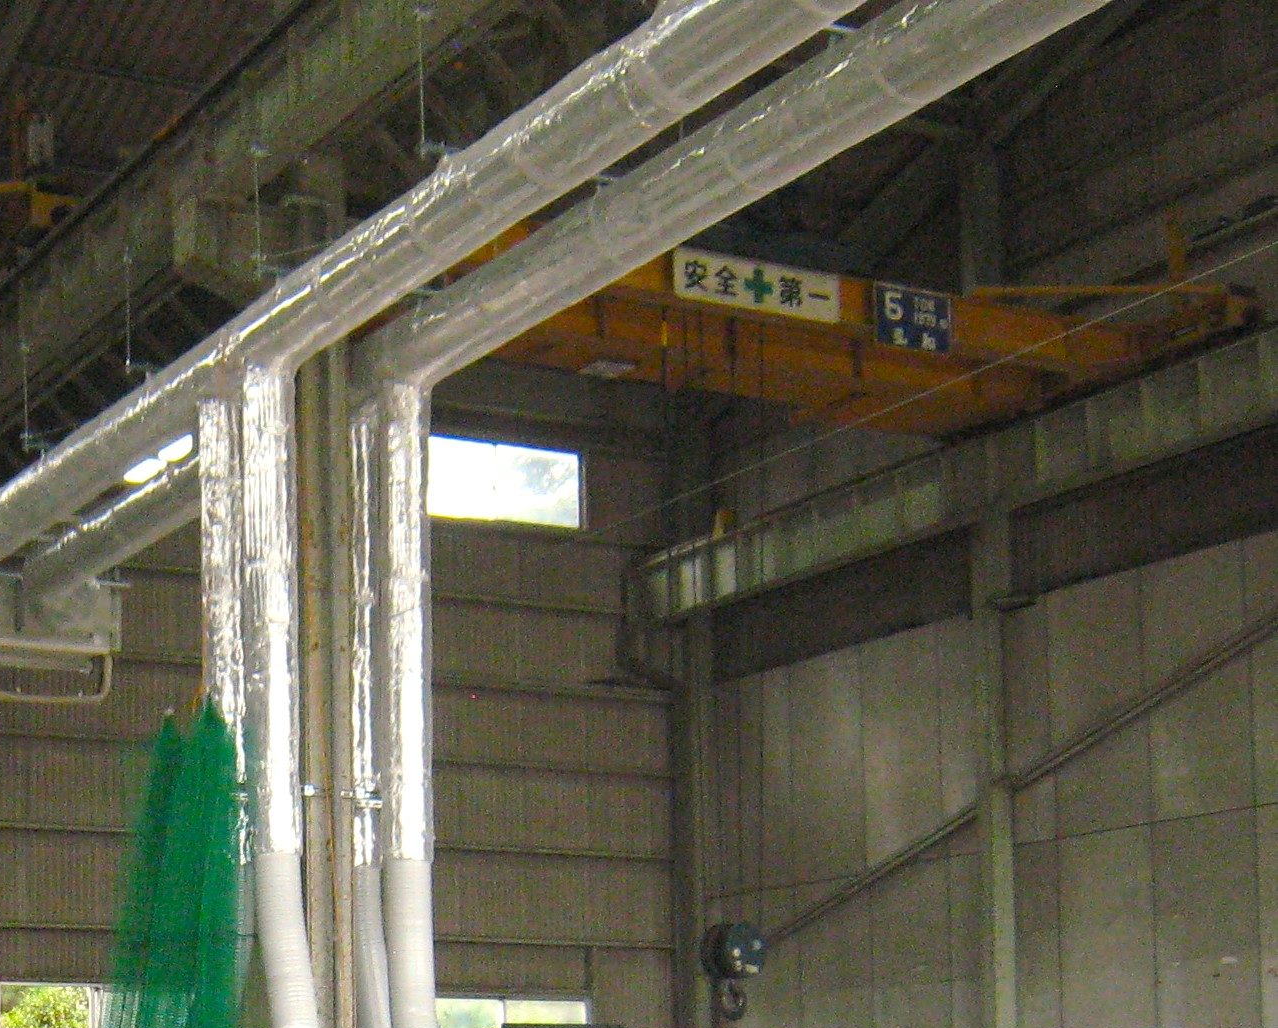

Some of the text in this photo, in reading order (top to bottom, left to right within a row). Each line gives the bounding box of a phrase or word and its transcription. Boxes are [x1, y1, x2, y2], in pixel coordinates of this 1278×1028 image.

[684, 260, 831, 308] 安全 第一
[884, 291, 904, 321] 5
